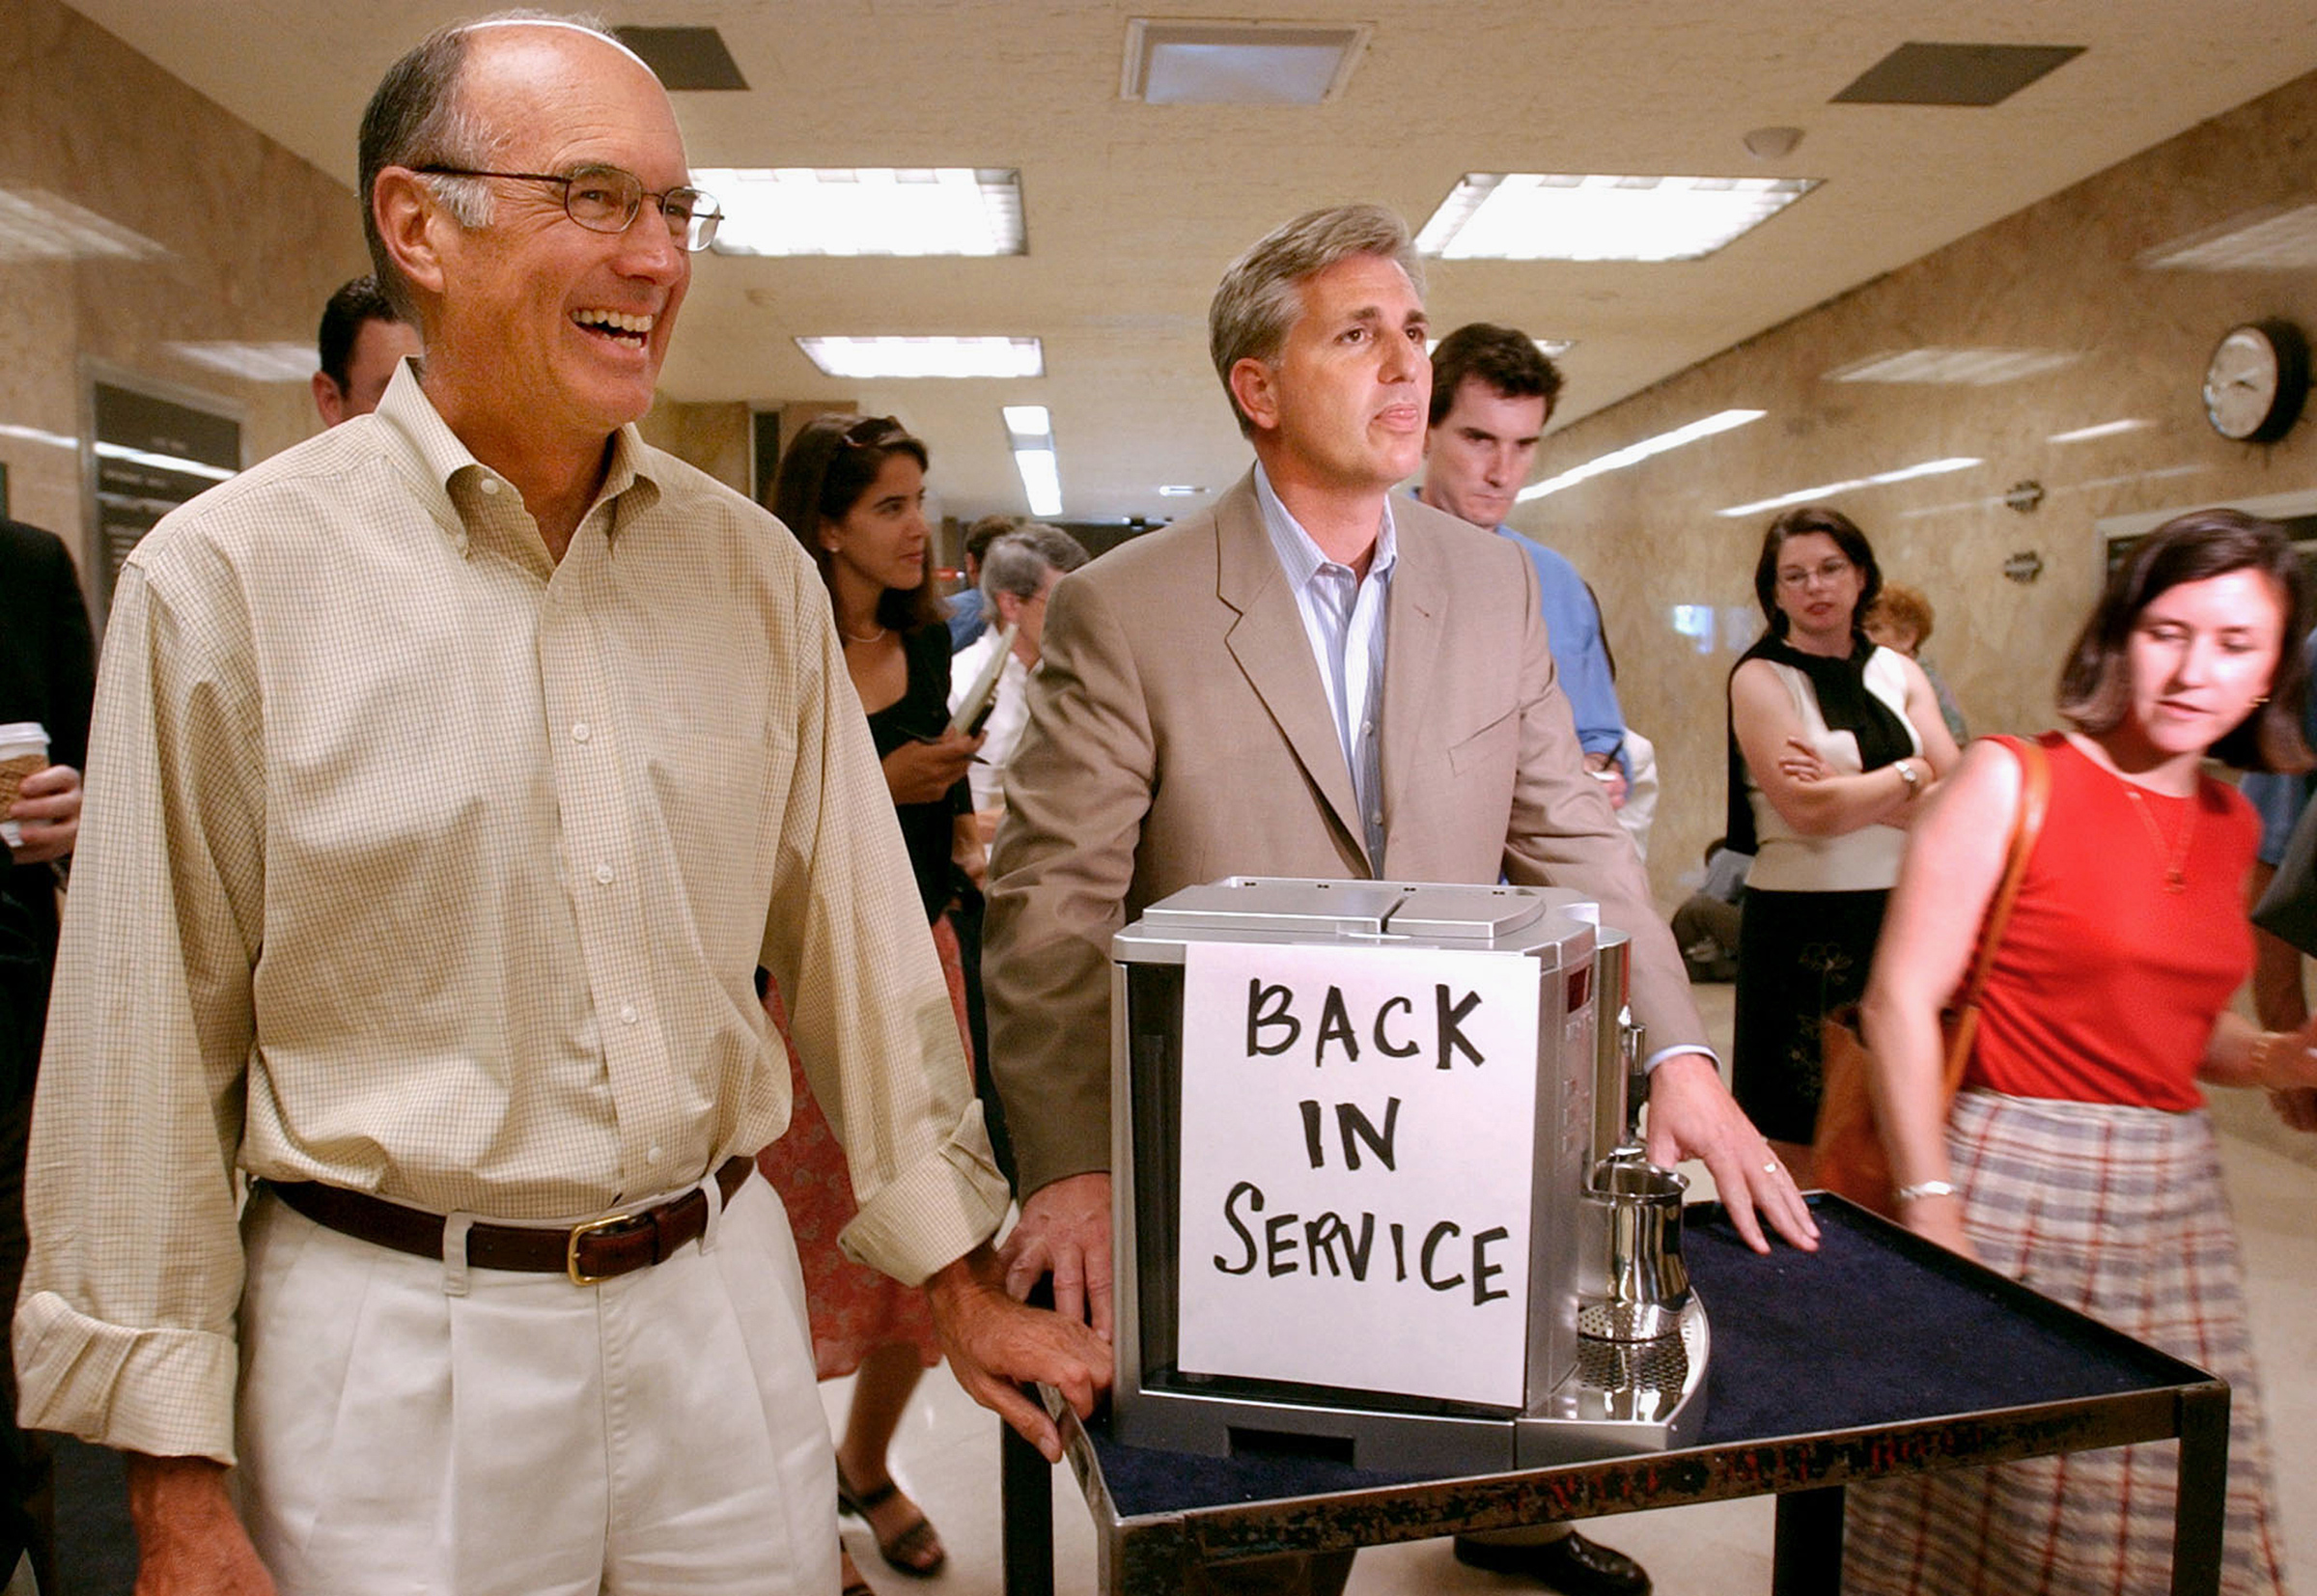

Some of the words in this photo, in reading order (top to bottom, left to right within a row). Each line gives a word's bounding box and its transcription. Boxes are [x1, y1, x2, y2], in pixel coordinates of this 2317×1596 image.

[1246, 978, 1485, 1070] BACK
[1298, 1097, 1401, 1172] IN
[1214, 1181, 1509, 1306] SERVICE
